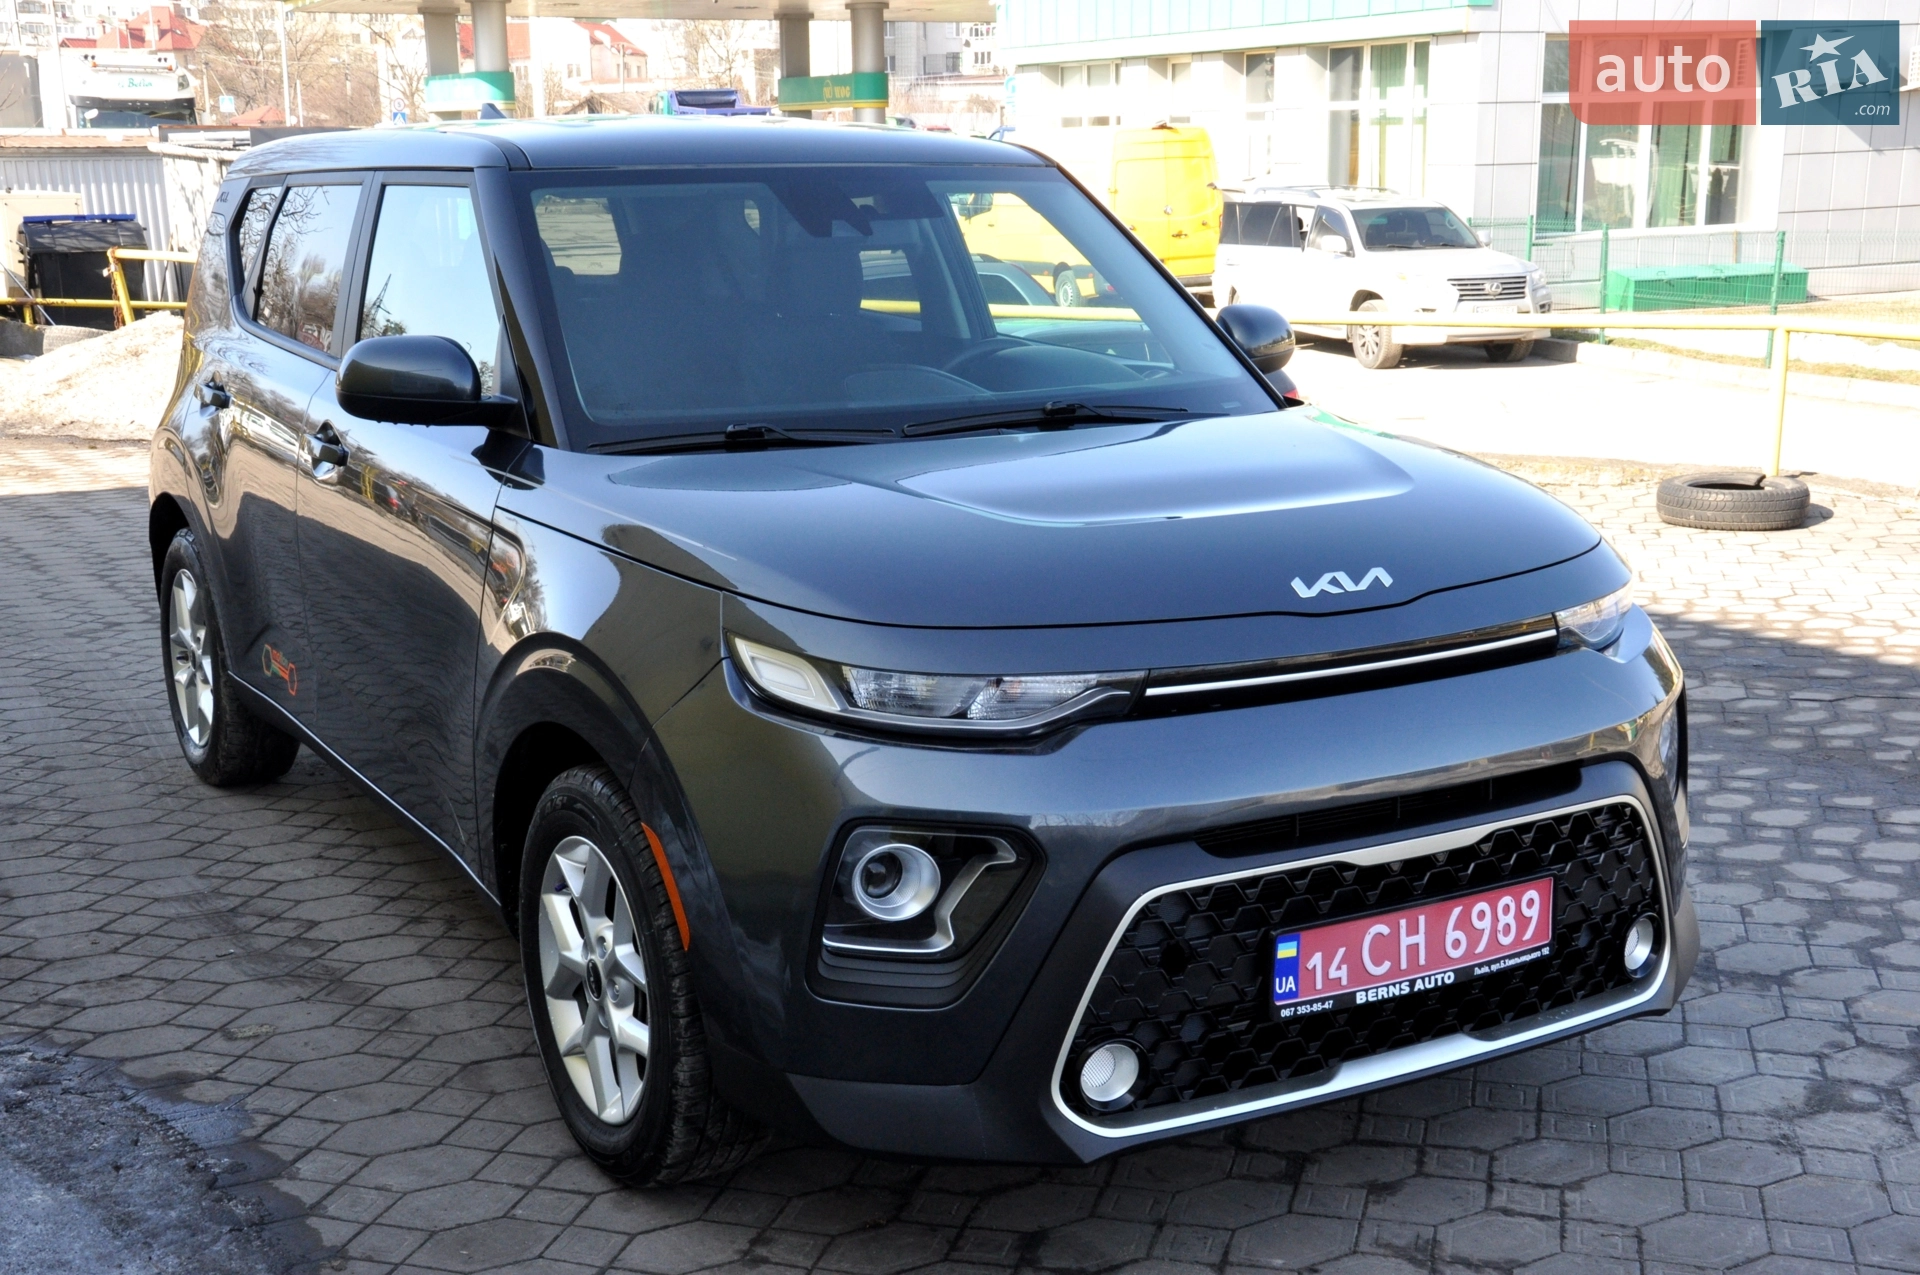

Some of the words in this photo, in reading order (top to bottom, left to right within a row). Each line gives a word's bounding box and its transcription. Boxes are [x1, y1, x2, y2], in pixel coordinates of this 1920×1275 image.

[1290, 567, 1394, 598] KIA
[1306, 947, 1348, 990] 14
[1361, 914, 1426, 976] CH
[1444, 889, 1541, 959] 6989
[1275, 975, 1296, 994] UA
[1356, 980, 1410, 1005] BERNS
[1414, 970, 1455, 992] AUTO
[1280, 1007, 1295, 1018] 067
[1296, 1000, 1334, 1015] 353-85-47
